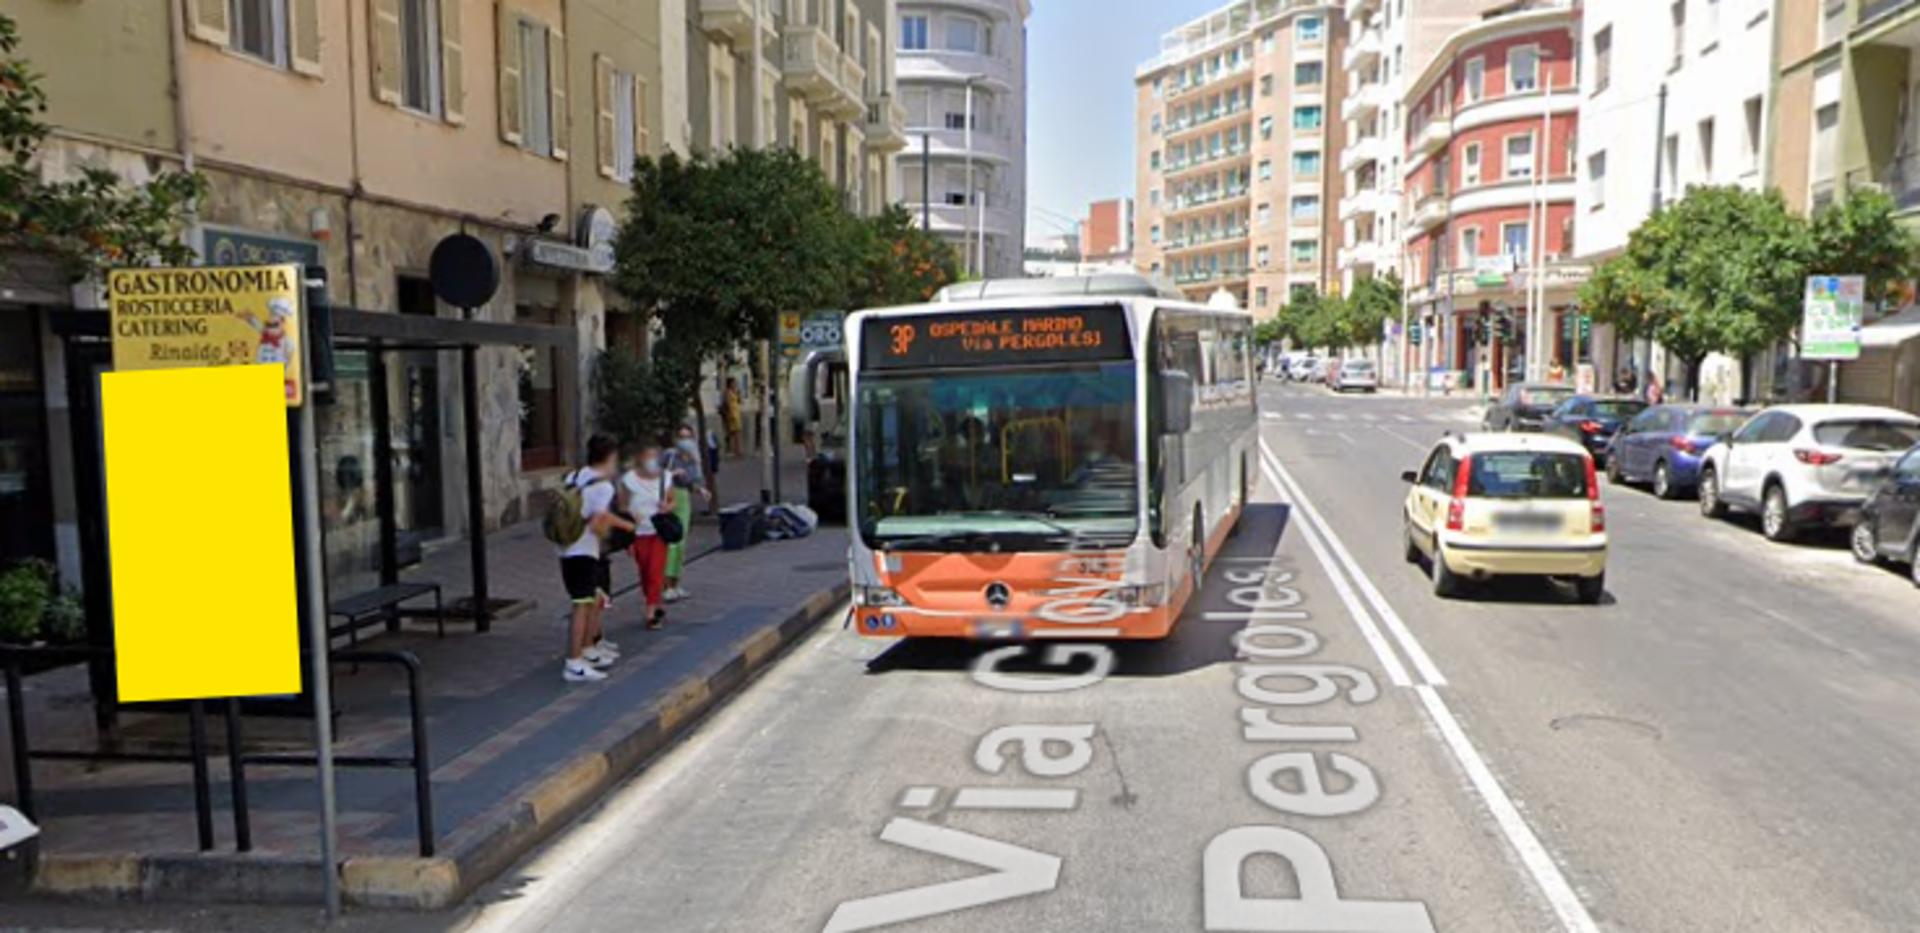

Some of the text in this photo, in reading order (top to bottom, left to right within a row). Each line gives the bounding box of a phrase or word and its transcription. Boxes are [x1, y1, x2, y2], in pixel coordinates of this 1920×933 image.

[114, 270, 289, 295] GASTRONOMIA
[116, 298, 233, 316] ROSTICCERIA
[118, 317, 208, 337] CATERING
[802, 327, 840, 343] ORO
[928, 315, 1083, 338] OSPEDALE MARINO
[890, 323, 915, 355] 3P
[962, 330, 1101, 351] Via PERGOLESI
[149, 343, 222, 361] Rinaldo
